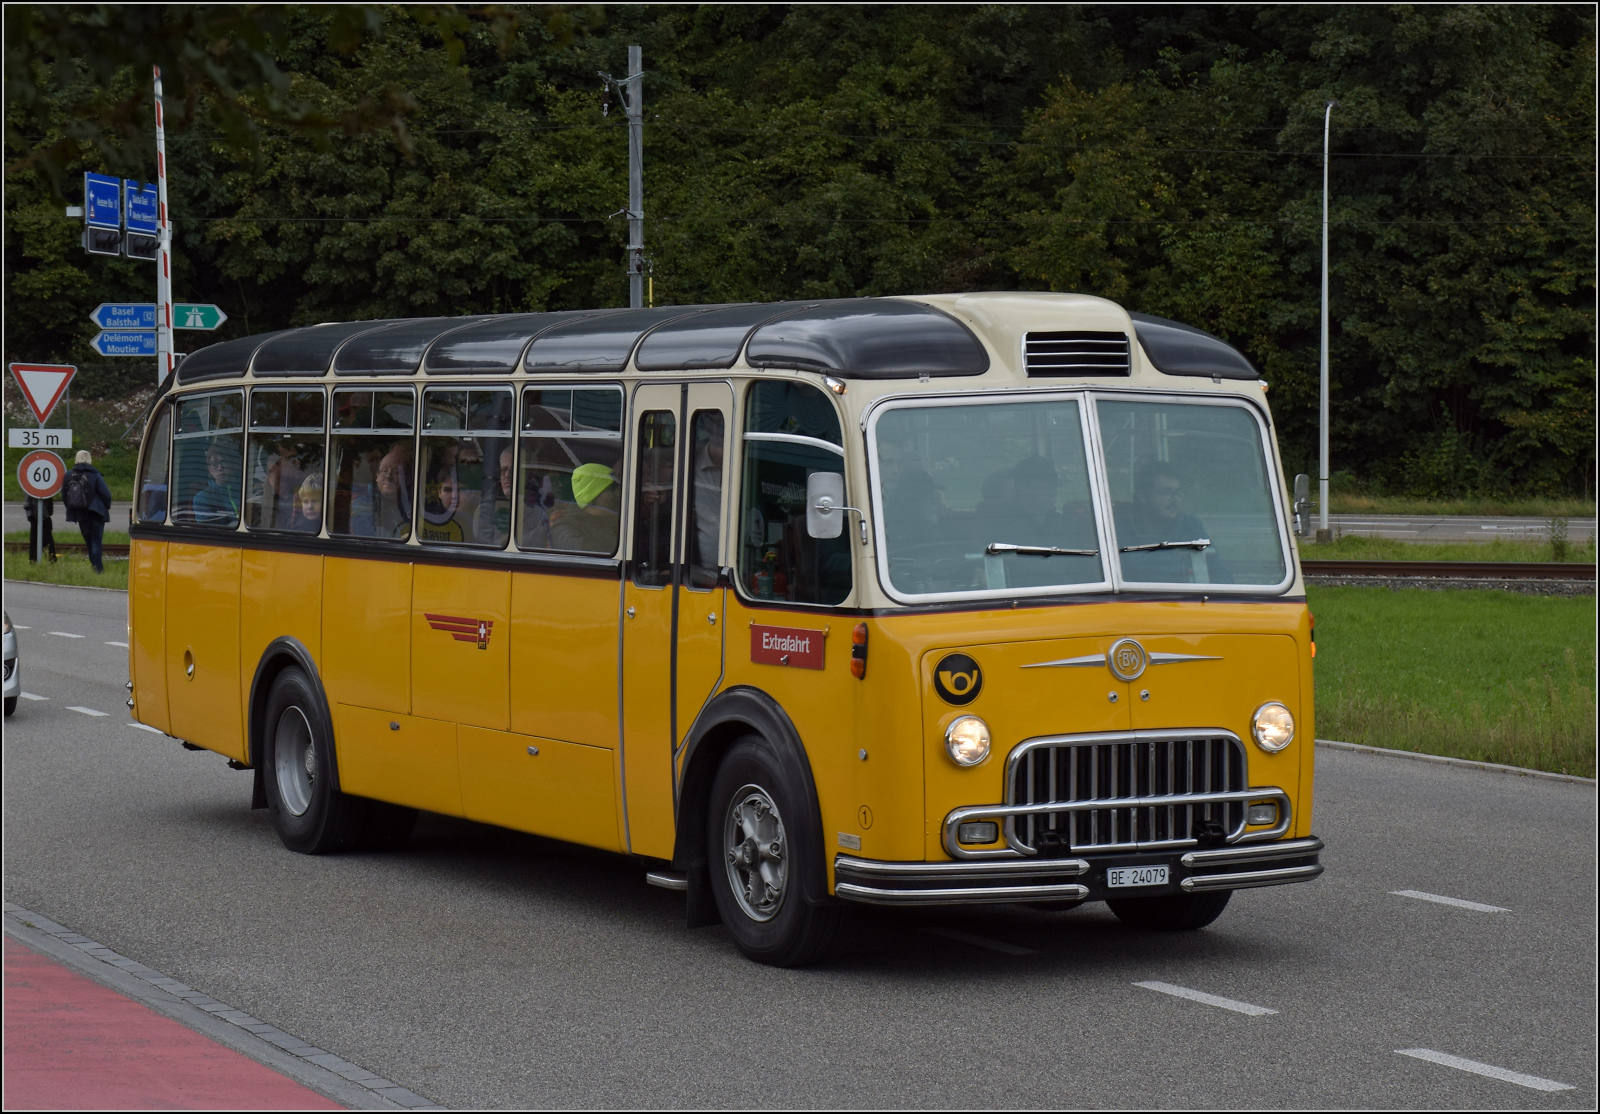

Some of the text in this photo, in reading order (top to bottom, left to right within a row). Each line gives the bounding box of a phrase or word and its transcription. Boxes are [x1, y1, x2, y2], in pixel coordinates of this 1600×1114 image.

[112, 306, 134, 316] Basel
[106, 318, 140, 326] Balsthal
[104, 333, 142, 342] Delémont
[107, 345, 139, 353] Moutier
[22, 432, 59, 445] 35 m
[33, 467, 50, 482] 60
[762, 632, 810, 653] Extrafahrt
